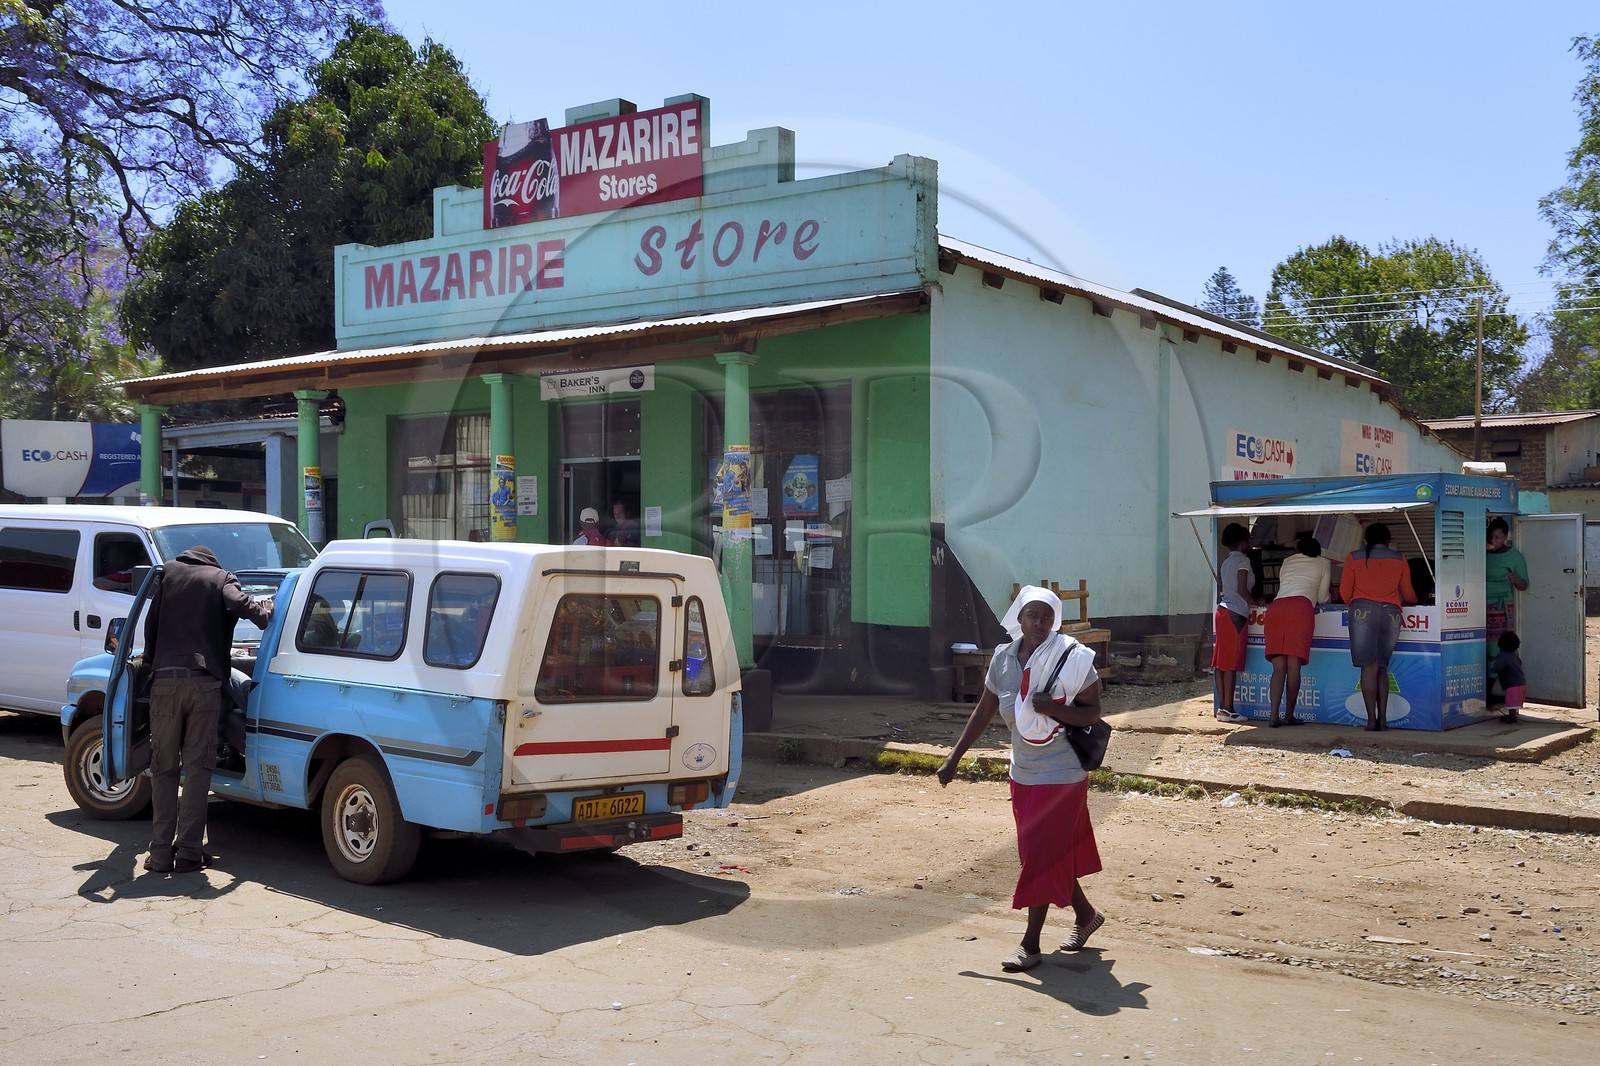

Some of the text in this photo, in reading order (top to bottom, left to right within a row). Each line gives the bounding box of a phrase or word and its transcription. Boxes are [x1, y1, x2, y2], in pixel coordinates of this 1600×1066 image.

[560, 108, 699, 177] MAZARIRE
[599, 173, 658, 201] Stores
[364, 238, 566, 310] MAZARIRE
[588, 385, 606, 394] INN
[1240, 673, 1257, 683] YOUR
[1233, 685, 1256, 703] ERE
[1296, 689, 1320, 707] REE
[609, 797, 639, 816] 6022
